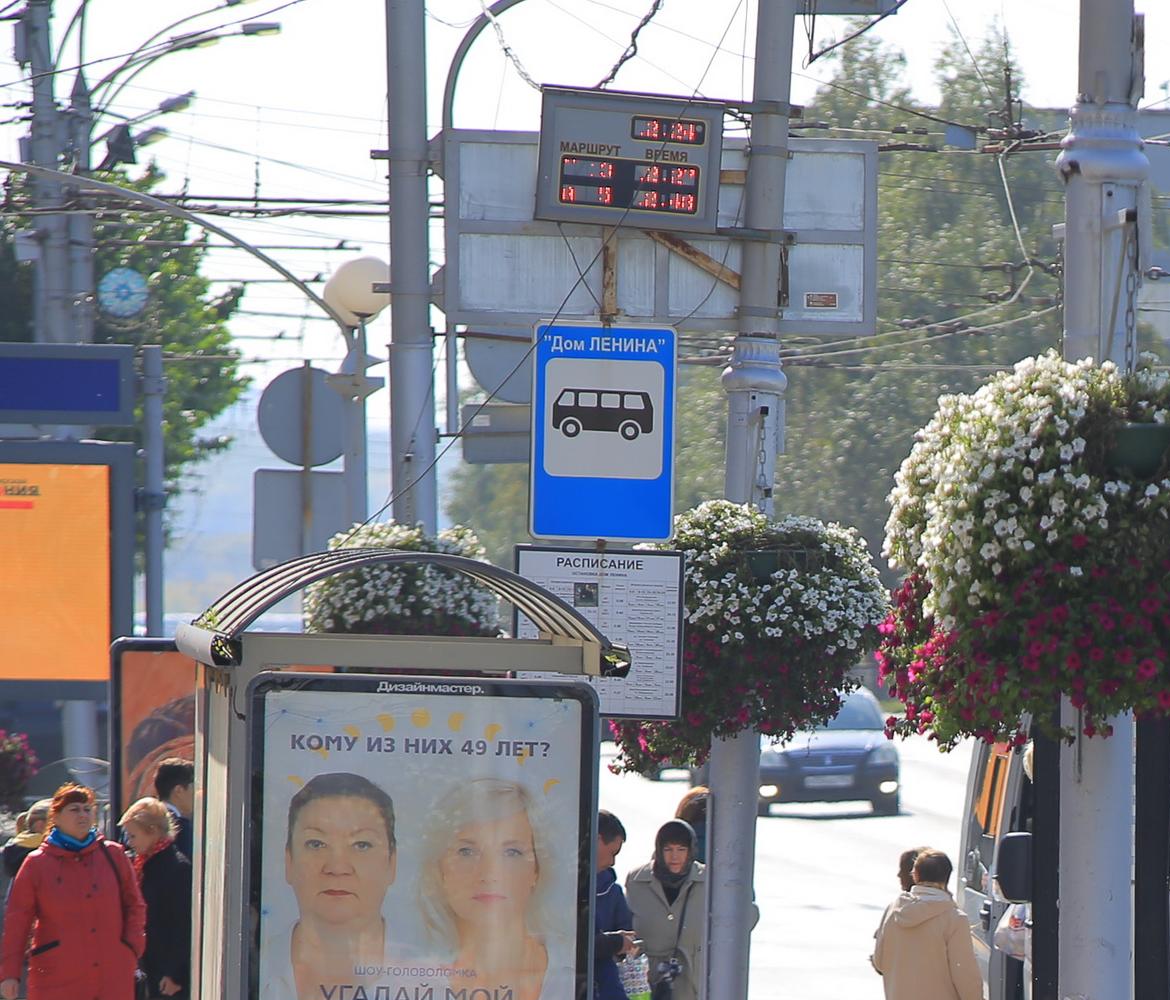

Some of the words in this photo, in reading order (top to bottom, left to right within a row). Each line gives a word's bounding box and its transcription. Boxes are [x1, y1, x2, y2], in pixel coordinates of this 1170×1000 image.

[560, 141, 621, 157] МАРШРУТ
[645, 149, 688, 162] ВРЕМЯ
[556, 557, 644, 570] РАСПИСАНИЕ
[377, 681, 484, 695] Дизайнмастер.
[290, 734, 358, 752] КОМУ
[366, 737, 396, 753] ИЗ
[404, 738, 453, 755] НИХ
[461, 739, 487, 755] 49
[495, 741, 551, 757] ЛЕТ?
[354, 966, 477, 978] ШОУ-ГОЛОВОЛОМКА
